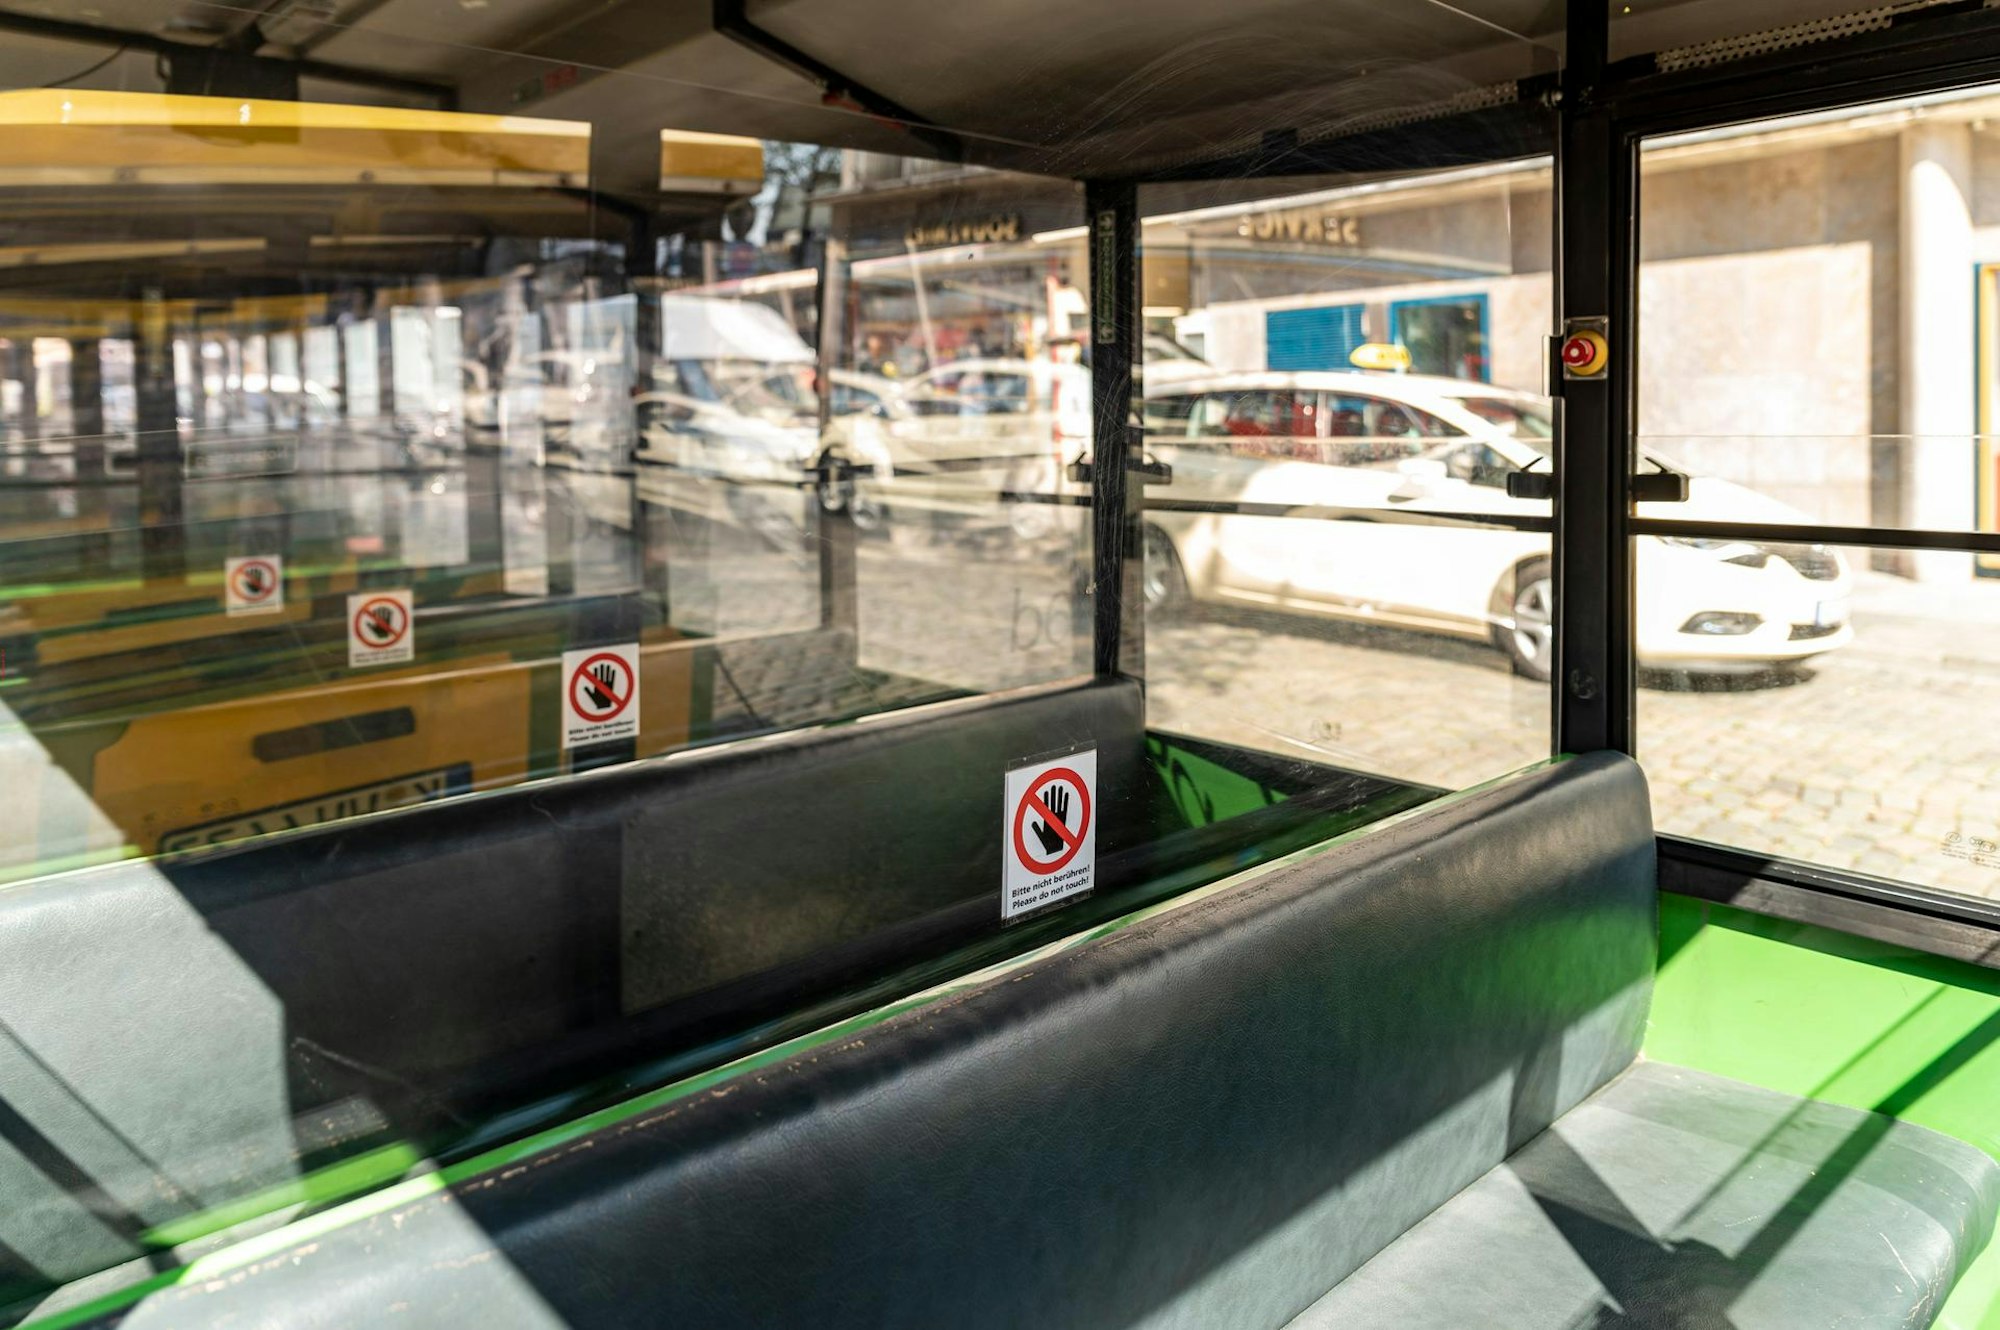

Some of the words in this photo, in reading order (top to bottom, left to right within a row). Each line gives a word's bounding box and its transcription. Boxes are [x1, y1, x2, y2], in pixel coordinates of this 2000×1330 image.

[1012, 886, 1031, 898] Bitte
[1033, 878, 1052, 891] nicht
[1054, 864, 1090, 883] berühren!
[1012, 896, 1037, 909] Please
[1039, 891, 1049, 900] do
[1051, 886, 1064, 896] not
[1065, 876, 1089, 890] touch!
